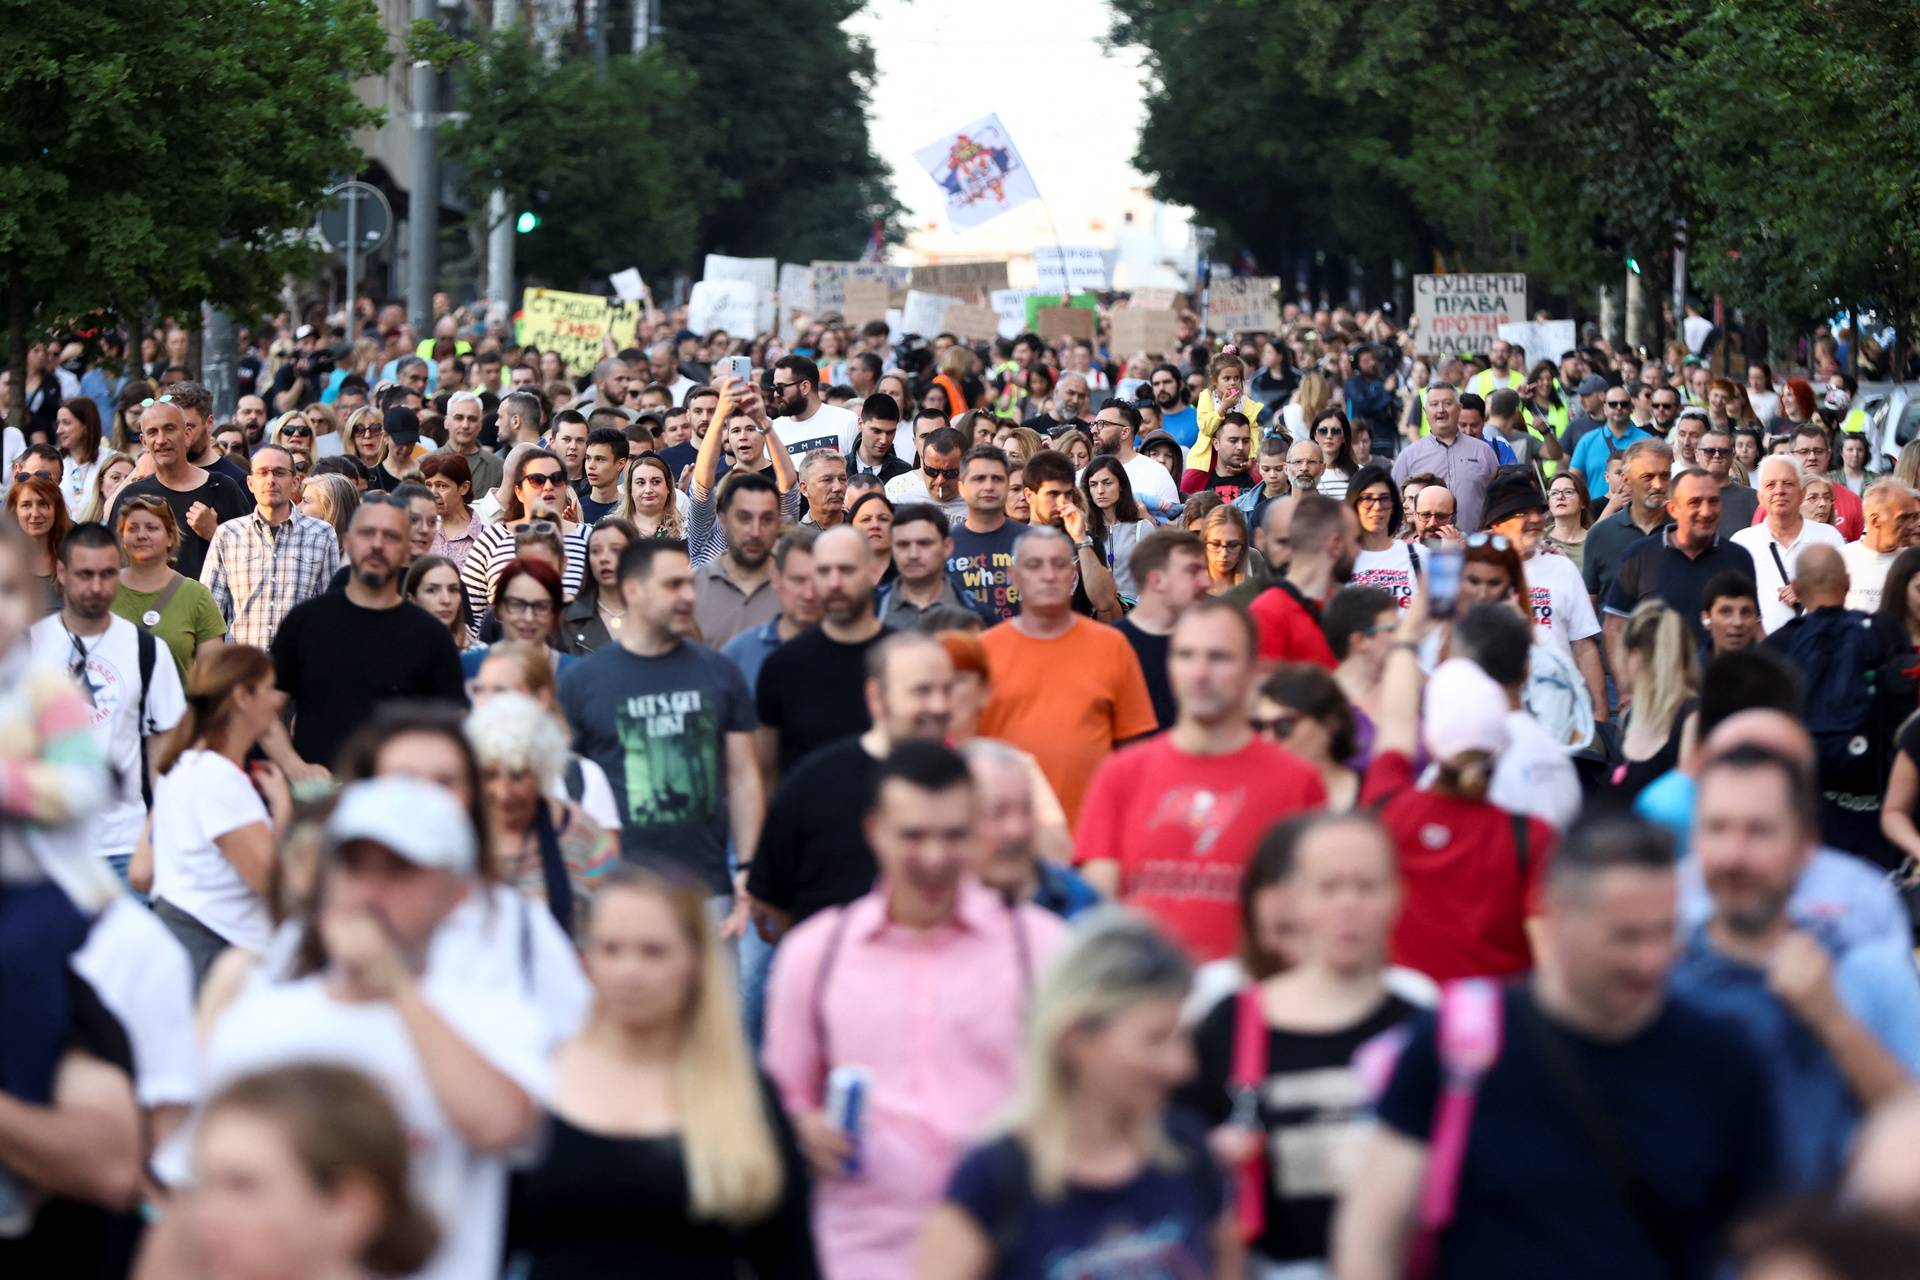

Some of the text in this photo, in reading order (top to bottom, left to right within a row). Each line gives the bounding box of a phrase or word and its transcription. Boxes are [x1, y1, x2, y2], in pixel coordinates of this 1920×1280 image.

[1418, 275, 1526, 295] СТУДЕНТИ
[1435, 296, 1508, 314] ПРАВА
[788, 437, 835, 453] OMMY
[946, 552, 987, 572] text
